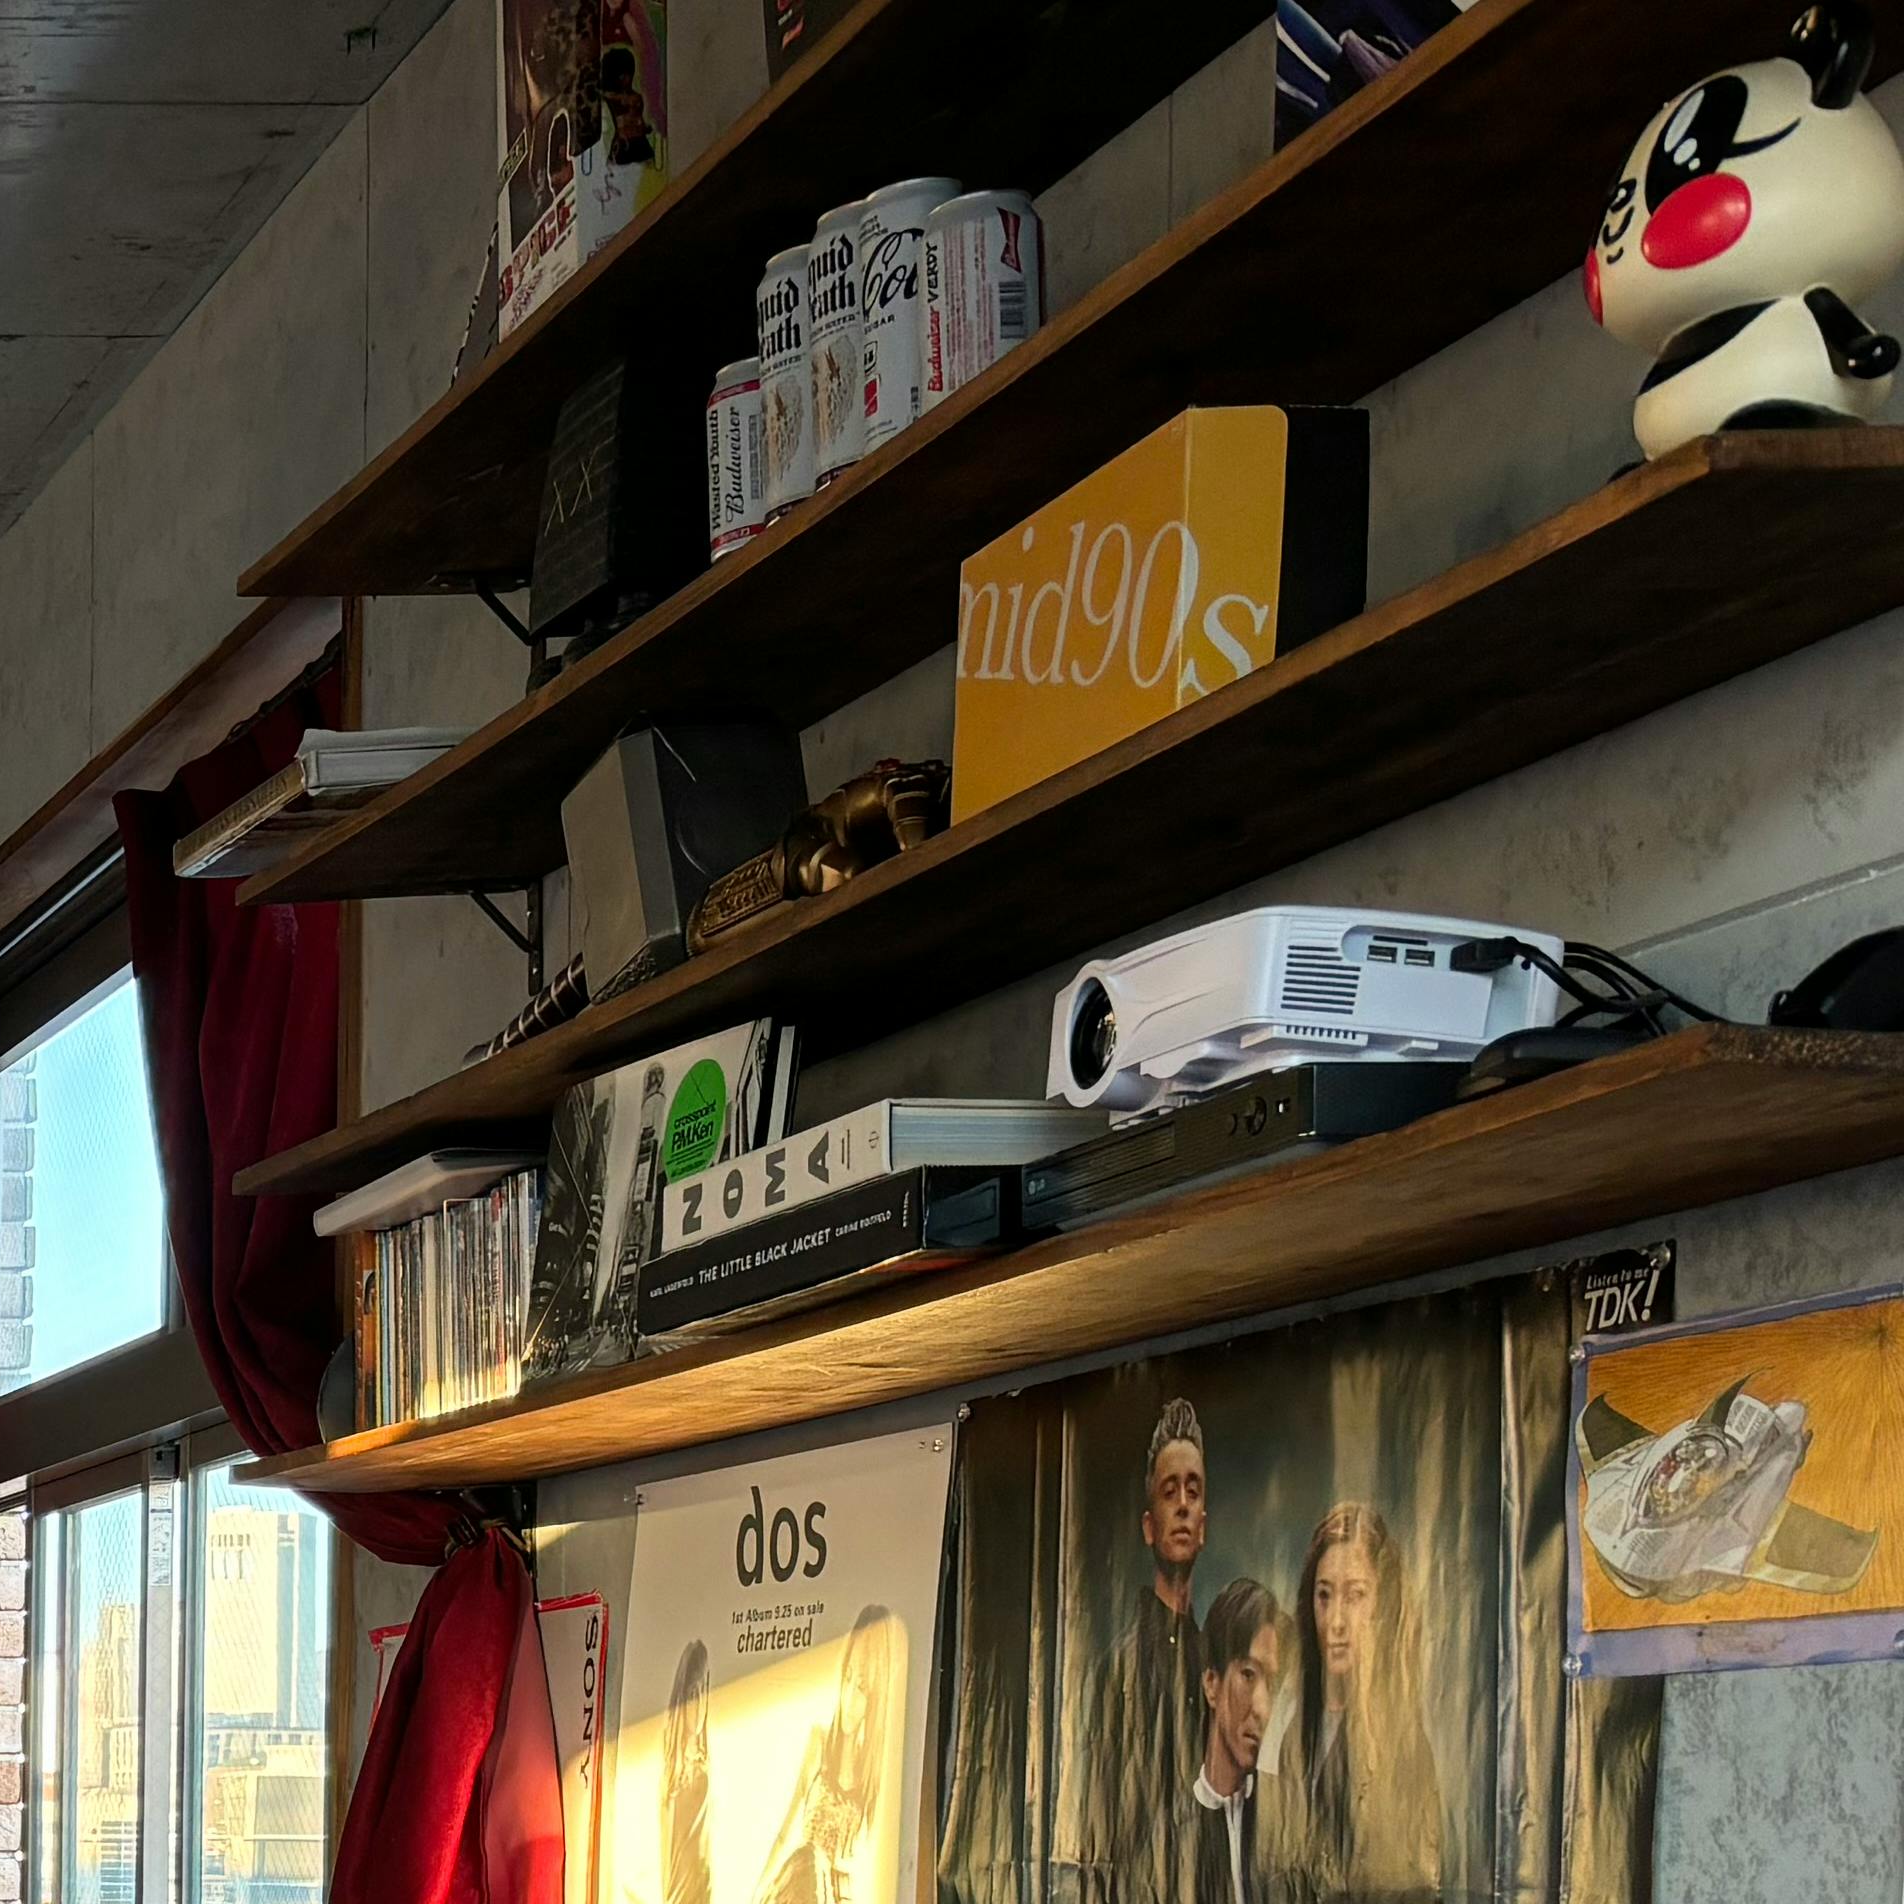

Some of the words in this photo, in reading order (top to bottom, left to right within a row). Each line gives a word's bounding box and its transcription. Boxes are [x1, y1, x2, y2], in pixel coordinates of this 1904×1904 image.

[725, 406, 744, 523] Budweiser
[699, 1265, 718, 1285] THE
[721, 1254, 752, 1278] LITTLE
[755, 1241, 787, 1266] BLACK
[790, 1228, 831, 1256] JACKET
[1586, 1272, 1619, 1290] Listen
[735, 1485, 828, 1587] dos
[736, 1618, 813, 1654] chartered
[806, 1600, 825, 1615] sale
[580, 1614, 599, 1789] SONY
